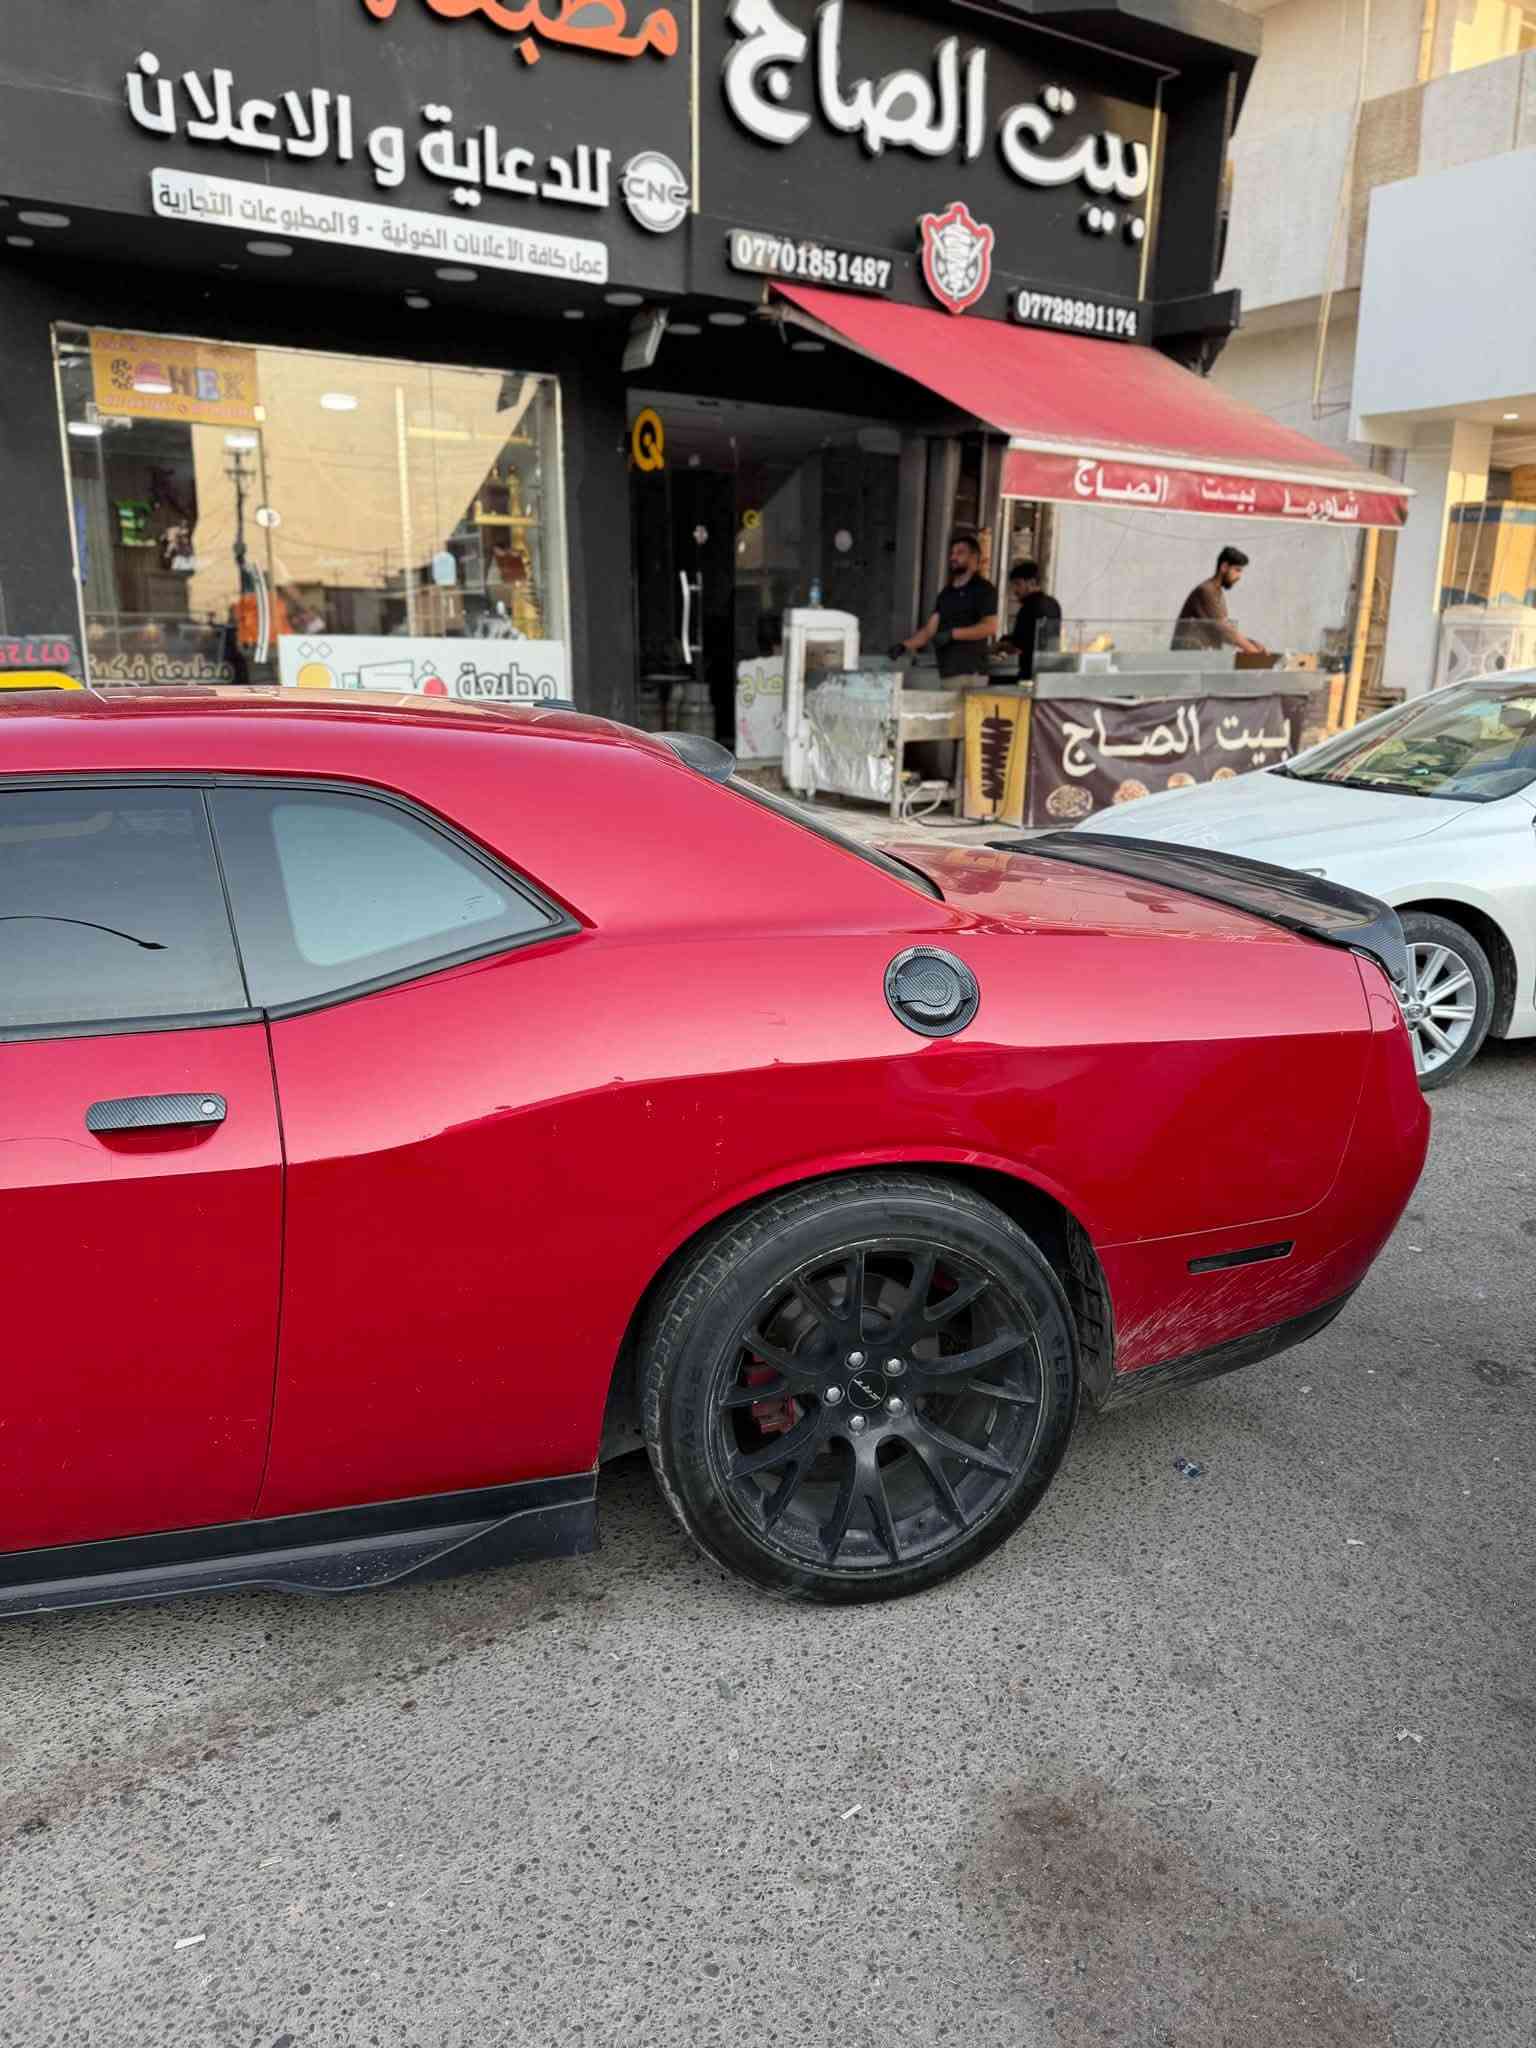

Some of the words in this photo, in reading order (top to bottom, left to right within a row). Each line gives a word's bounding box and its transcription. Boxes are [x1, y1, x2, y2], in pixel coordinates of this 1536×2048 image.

[725, 0, 987, 158] الصاج
[126, 51, 354, 160] الاعلان
[368, 125, 406, 187] و
[420, 103, 612, 208] للدعاية
[1002, 86, 1149, 239] بيت
[158, 184, 233, 218] التجارية
[626, 177, 686, 207] CNC
[528, 243, 568, 270] كافة
[569, 252, 604, 276] عمل
[736, 233, 892, 289] 07701851487
[1072, 458, 1169, 504] الصاج
[1200, 476, 1257, 512] بيت
[1282, 488, 1360, 522] شاورما
[1061, 704, 1201, 777] الصاج
[1215, 714, 1291, 765] بيت
